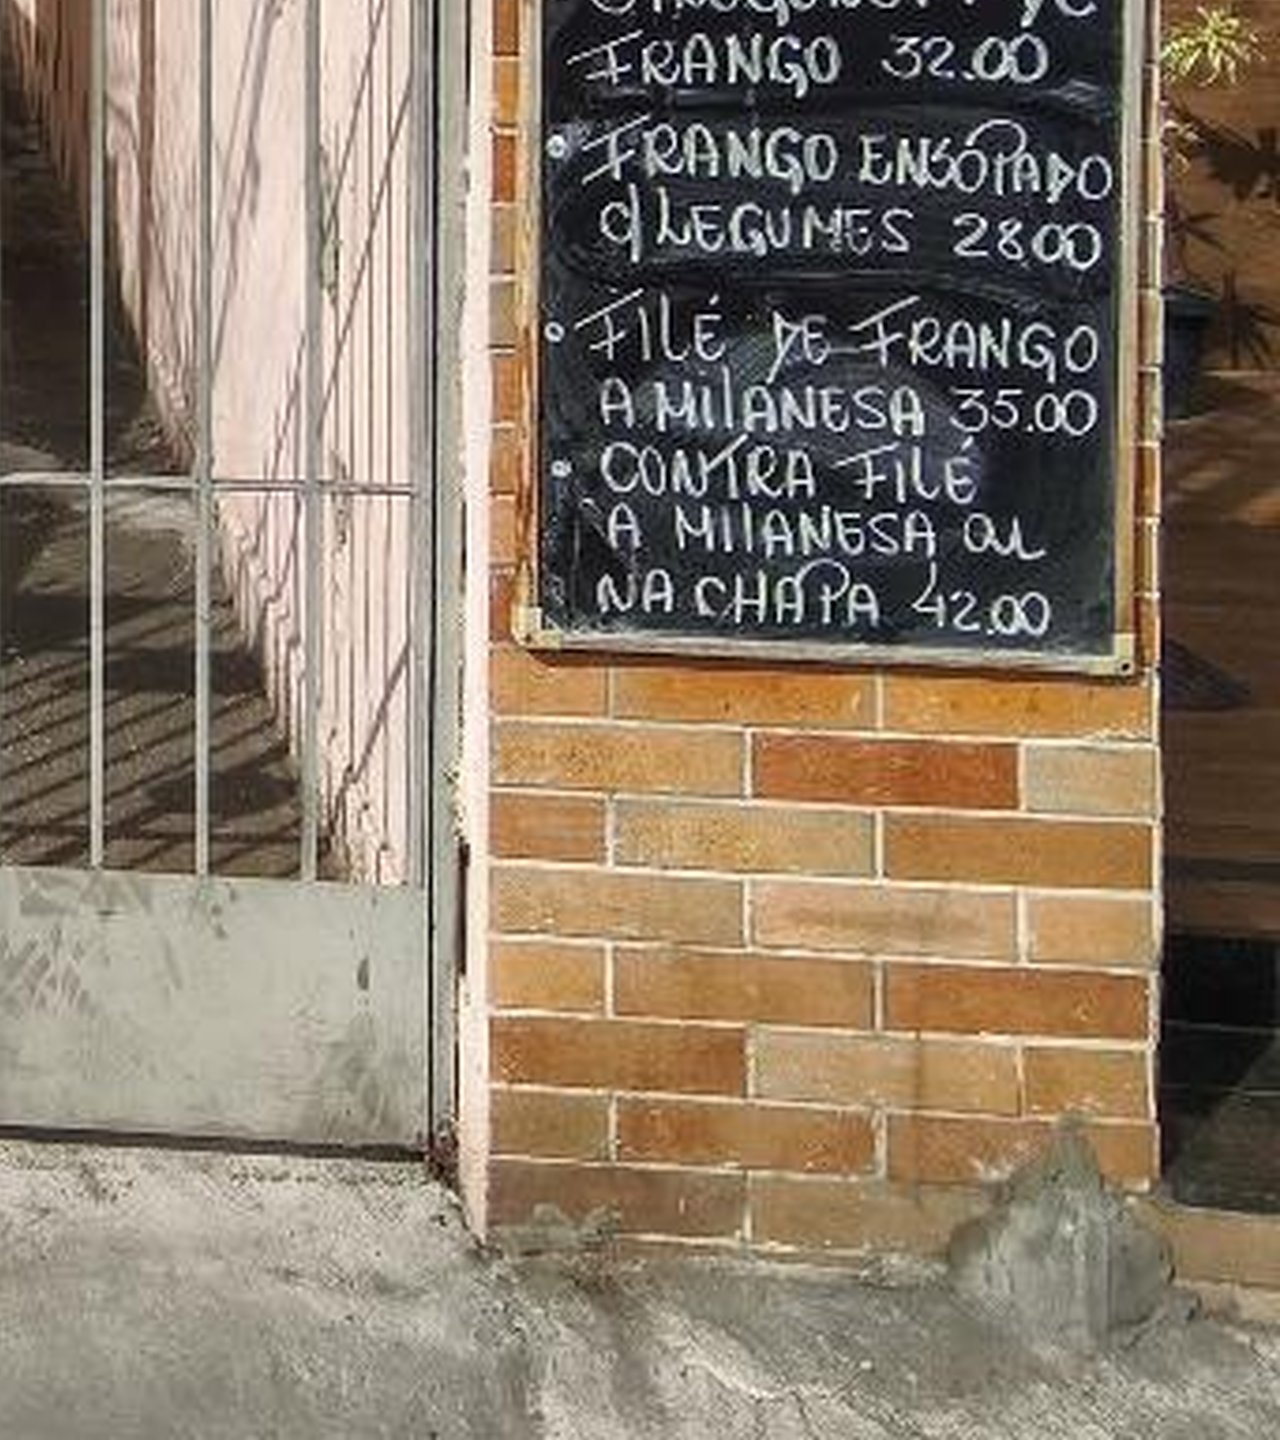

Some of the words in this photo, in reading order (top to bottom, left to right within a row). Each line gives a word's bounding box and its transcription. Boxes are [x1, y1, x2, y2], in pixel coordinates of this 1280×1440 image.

[567, 30, 840, 97] FRANGO
[881, 34, 1048, 86] 32.00
[581, 115, 836, 194] FRANGO
[768, 314, 831, 385] DE
[853, 297, 1097, 380] FRANGO
[656, 370, 925, 434] MILANESA
[949, 389, 1097, 434] 35.00
[600, 434, 816, 500] CONTRA
[674, 504, 936, 556] MILANESA
[596, 571, 674, 614] NA
[696, 558, 879, 629] CHAPA
[911, 563, 1049, 635] 42.00
